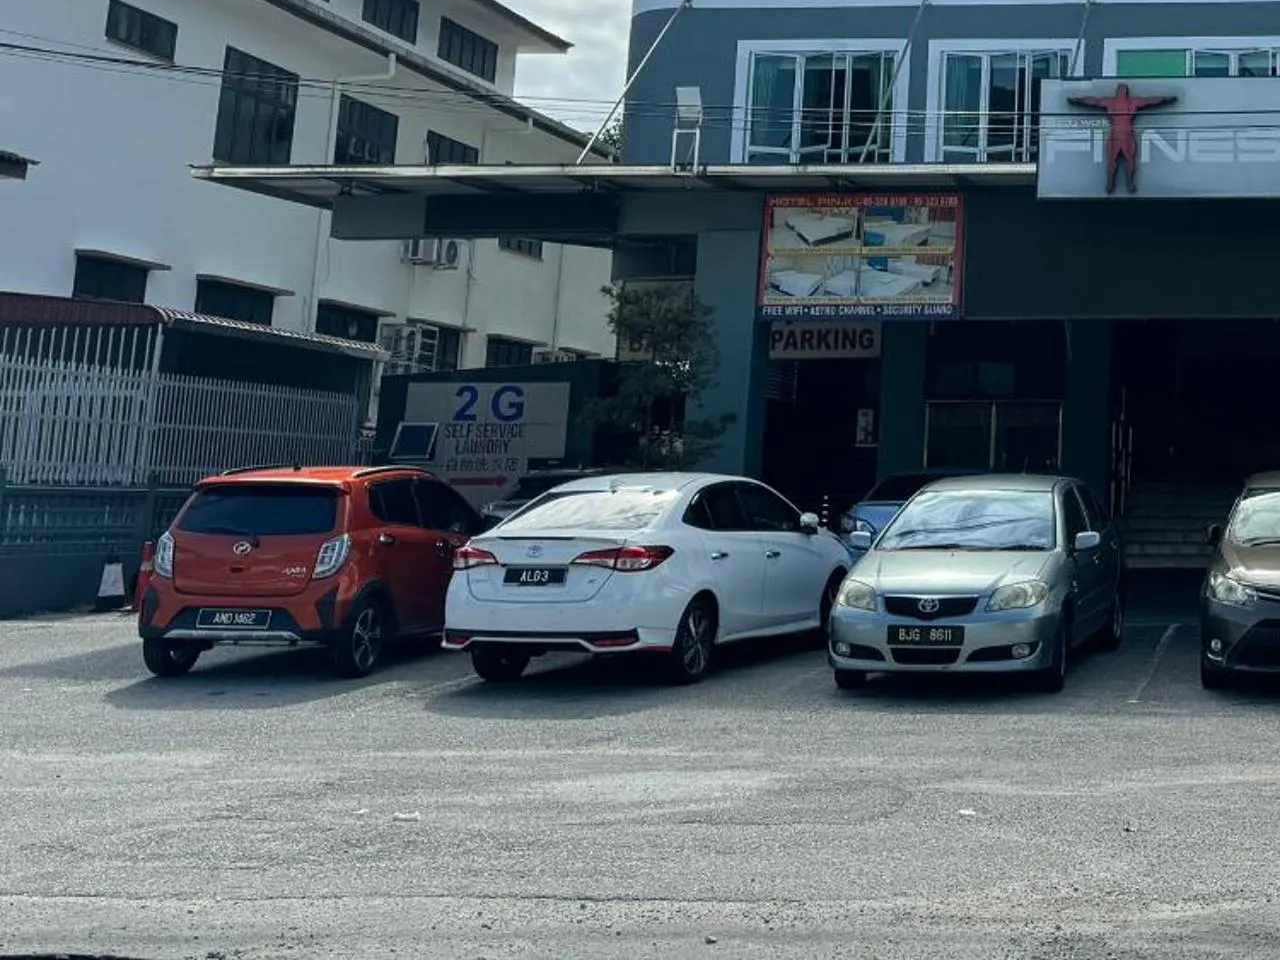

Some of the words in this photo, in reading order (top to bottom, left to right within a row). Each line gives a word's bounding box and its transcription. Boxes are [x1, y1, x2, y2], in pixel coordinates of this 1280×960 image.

[769, 197, 815, 207] HOTEL
[762, 305, 784, 316] FREE
[770, 329, 875, 351] PARKING
[452, 385, 479, 421] 2
[491, 385, 525, 422] G
[444, 423, 473, 438] SELF
[476, 423, 526, 439] SERVICE
[455, 439, 511, 455] LAUNDRY
